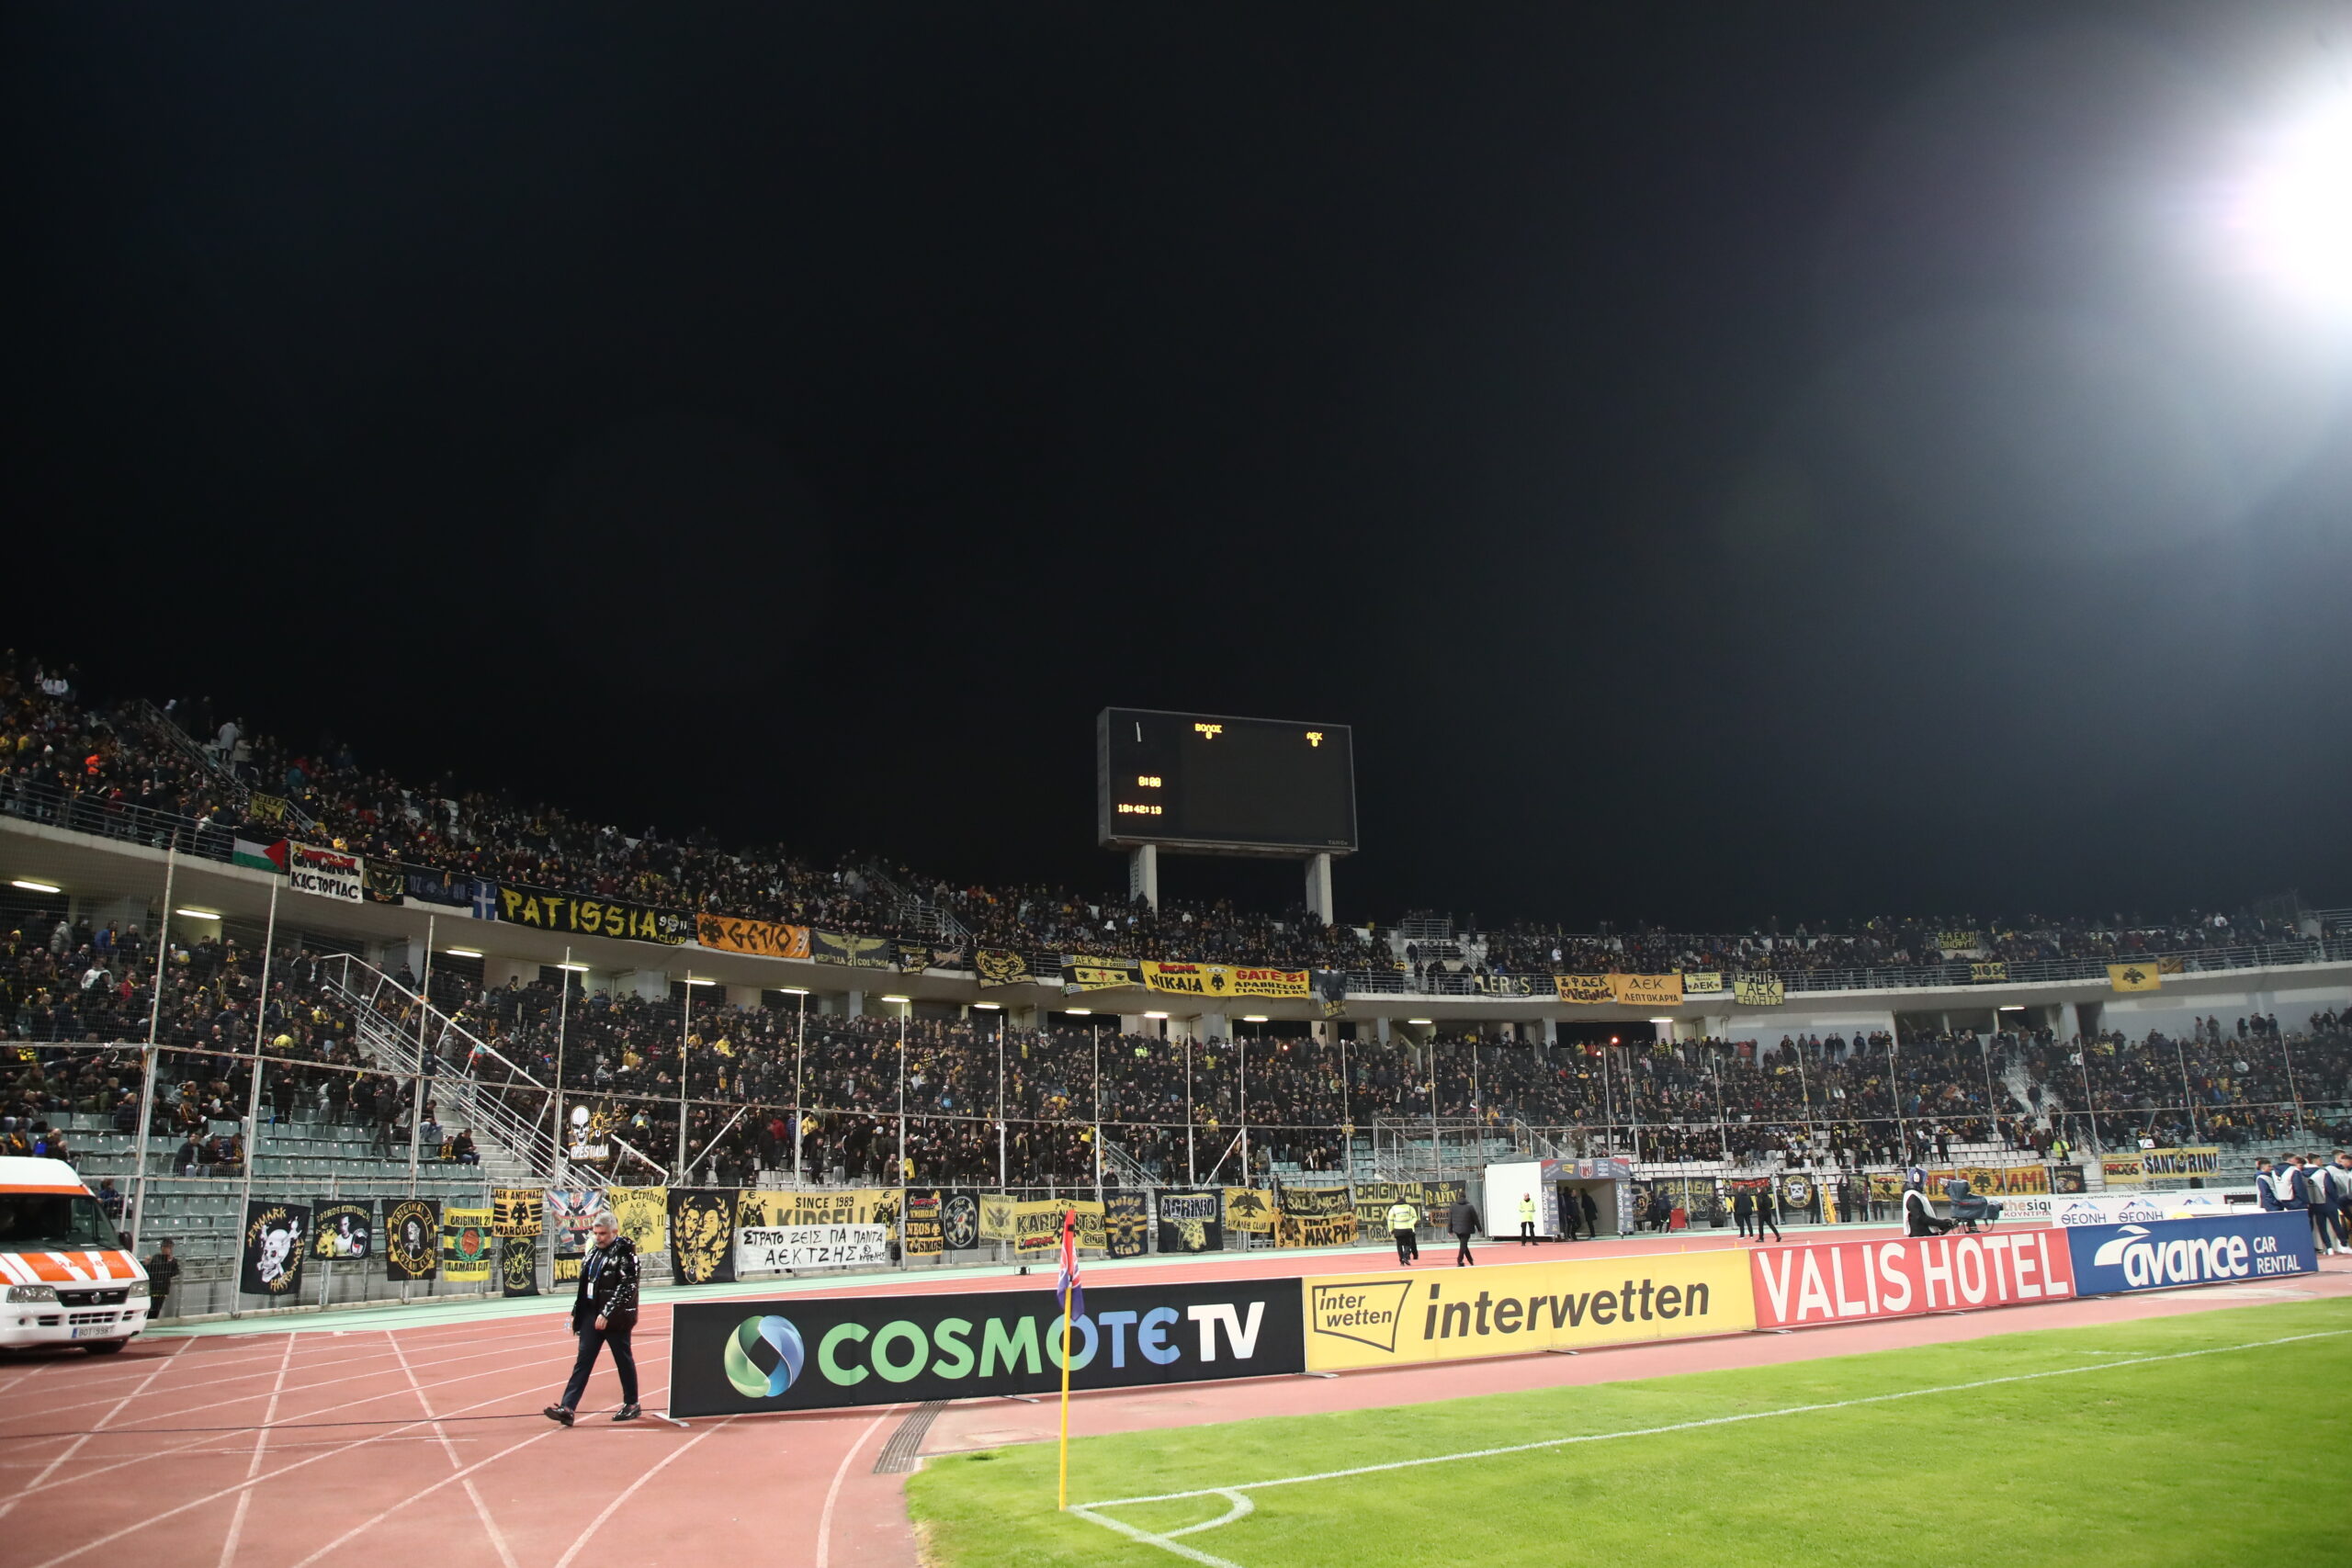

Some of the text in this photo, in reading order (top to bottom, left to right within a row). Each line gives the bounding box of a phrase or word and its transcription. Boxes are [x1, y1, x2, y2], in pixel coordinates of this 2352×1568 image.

[499, 886, 659, 940] PATISSIA
[1075, 956, 1094, 965] AEK
[1236, 970, 1306, 982] GATE 21
[2145, 1153, 2218, 1175] SANTORINI
[1356, 1182, 1420, 1200] ORIGINAL
[796, 1196, 854, 1208] SINCE 1989
[1162, 1198, 1216, 1217] AGRINIO
[450, 1215, 482, 1225] ORIGINAL
[744, 1230, 784, 1245] ΣΤΡΑΤΟ
[2253, 1236, 2277, 1254] CAR
[2123, 1235, 2248, 1287] avance
[2256, 1255, 2301, 1274] RENTAL
[1757, 1233, 2069, 1323] VALIS HOTEL
[1319, 1287, 1366, 1311] inter
[1326, 1308, 1393, 1327] wetten
[1423, 1280, 1710, 1340] interwetten
[817, 1301, 1265, 1386] COSMOTE TV
